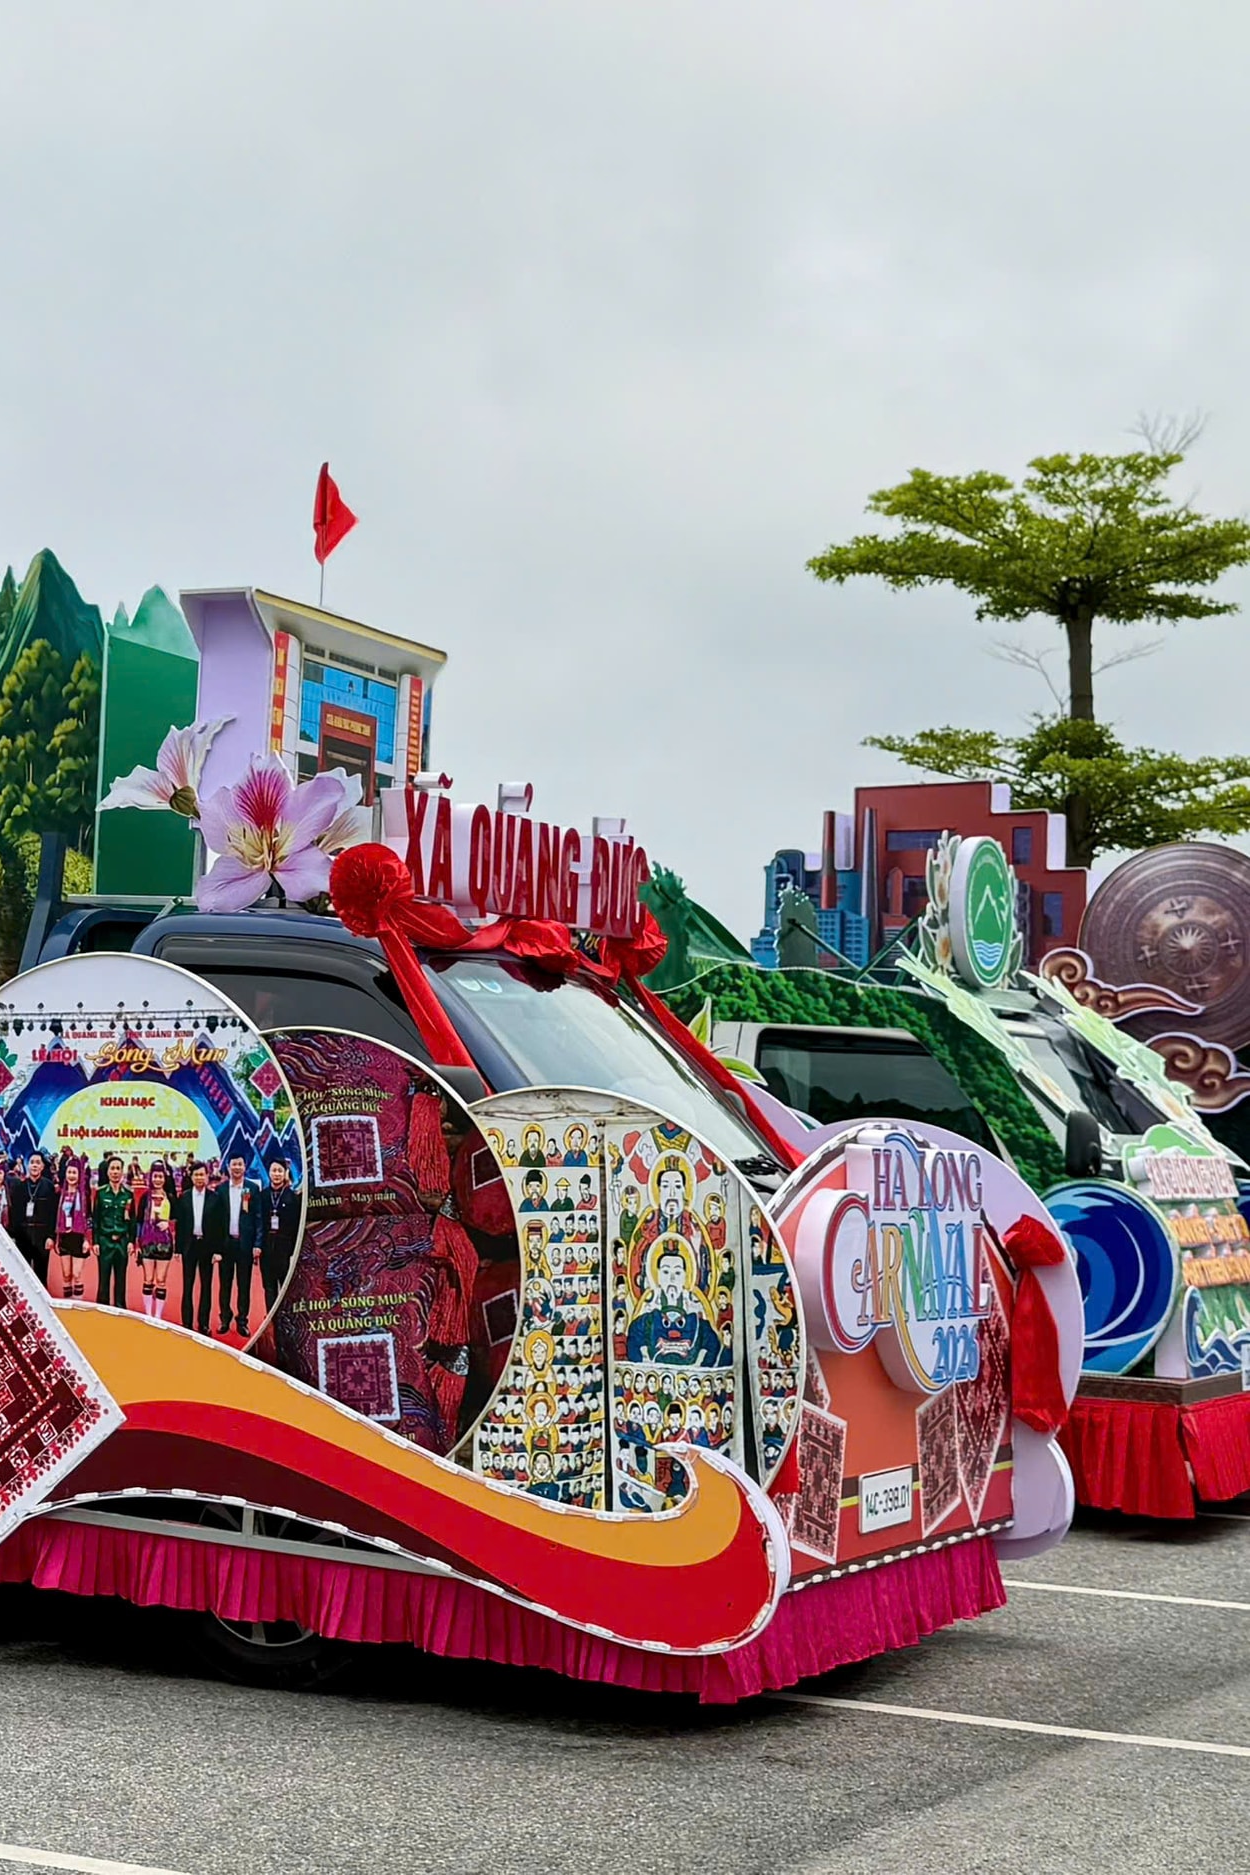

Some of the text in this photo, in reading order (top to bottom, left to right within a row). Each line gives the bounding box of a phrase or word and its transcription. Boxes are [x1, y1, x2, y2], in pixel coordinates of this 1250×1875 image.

[404, 772, 651, 939] XÃ QUẢNG ĐỨC
[100, 1096, 156, 1109] KHAI MẠC
[872, 1149, 982, 1212] HA LONG
[823, 1192, 992, 1352] CARNAVAL
[932, 1324, 979, 1383] 2026
